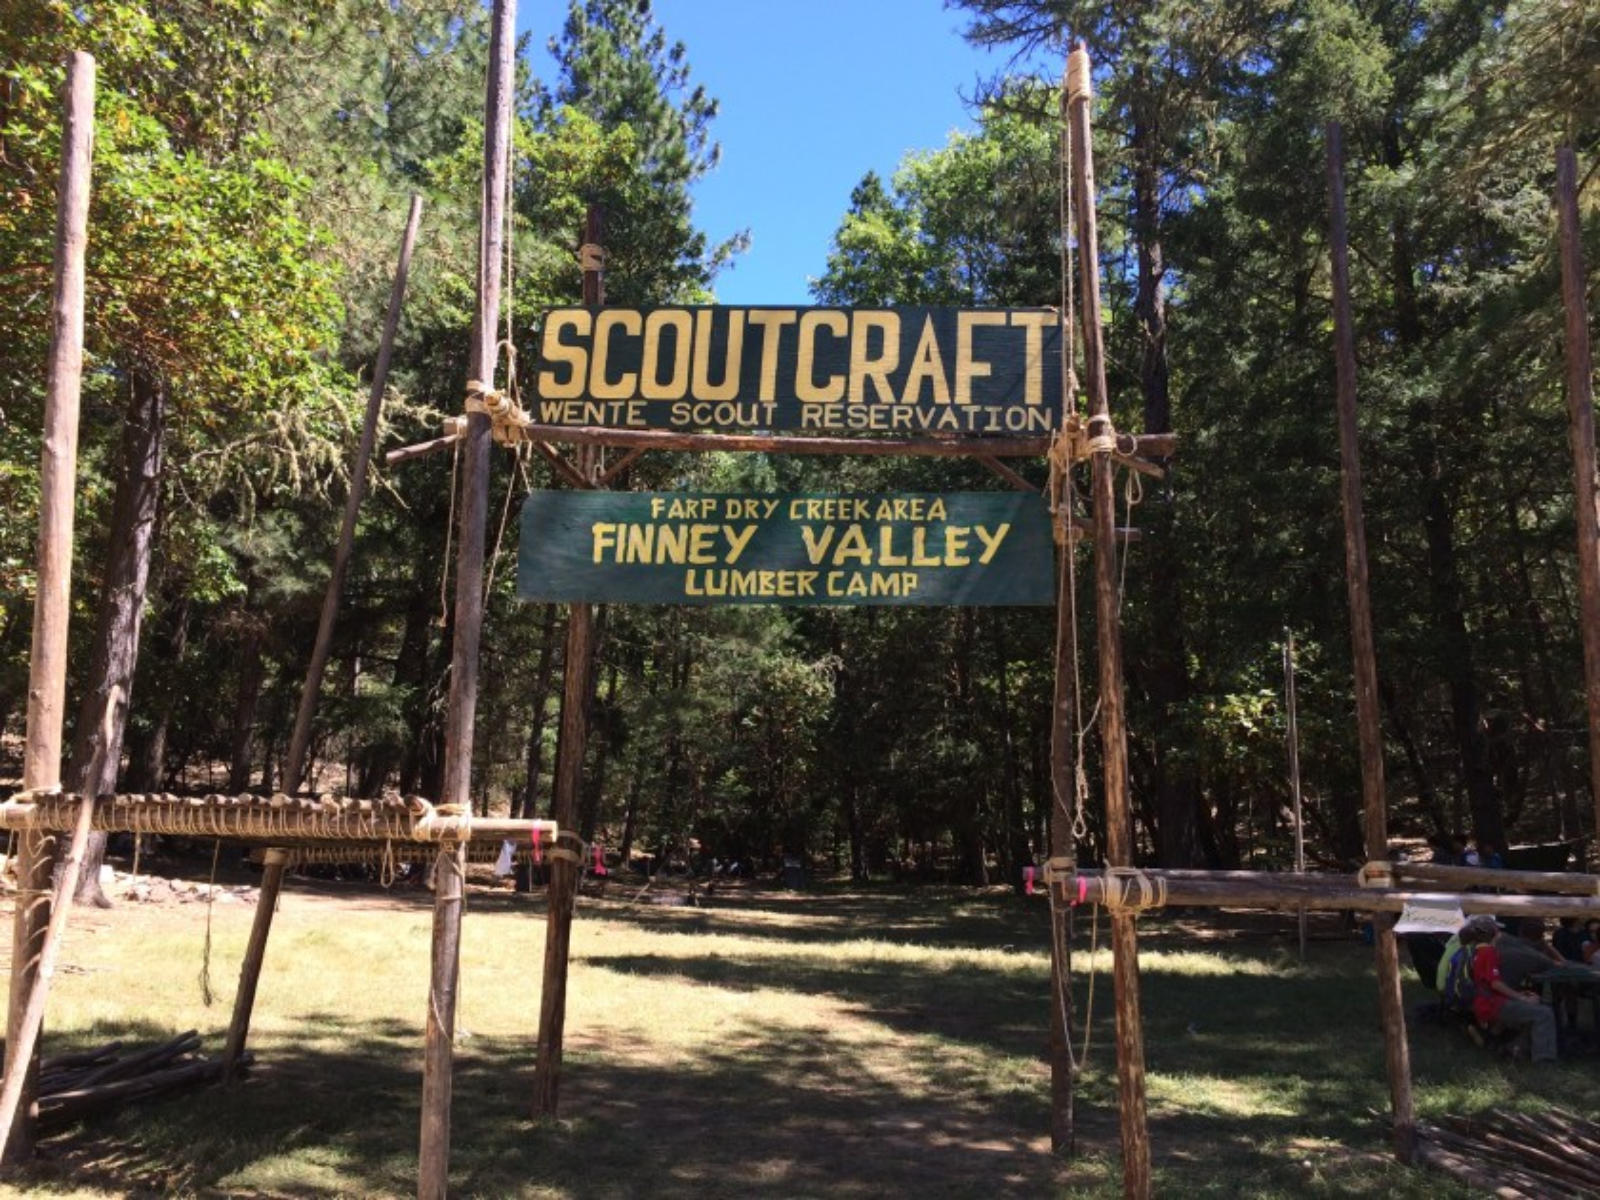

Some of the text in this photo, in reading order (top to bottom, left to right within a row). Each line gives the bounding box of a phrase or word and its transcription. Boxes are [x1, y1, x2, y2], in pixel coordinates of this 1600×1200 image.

[537, 307, 1060, 405] SCOUTCRAFT
[540, 401, 1053, 432] WENTE SCOUT RESERVATION
[726, 498, 779, 519] DRY
[789, 498, 870, 520] CREEK
[875, 499, 947, 521] AREA
[592, 521, 1010, 567] FINNEY VALLEY
[685, 568, 919, 597] LUMBER CAMP
